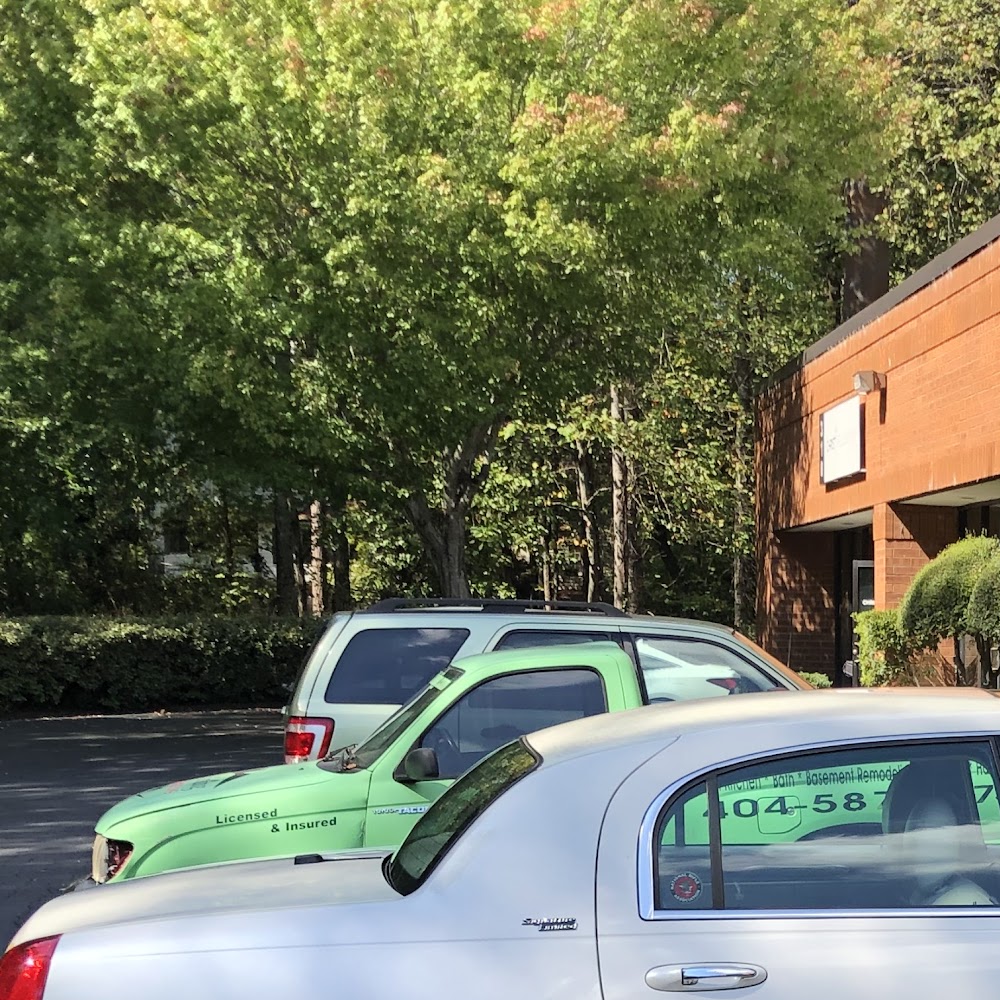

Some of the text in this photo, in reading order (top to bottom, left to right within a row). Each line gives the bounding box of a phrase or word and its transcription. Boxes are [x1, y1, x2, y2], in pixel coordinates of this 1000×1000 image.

[805, 768, 854, 786] Basement
[216, 808, 278, 824] Licensed
[398, 805, 427, 816] TACO
[270, 816, 337, 834] & Insured
